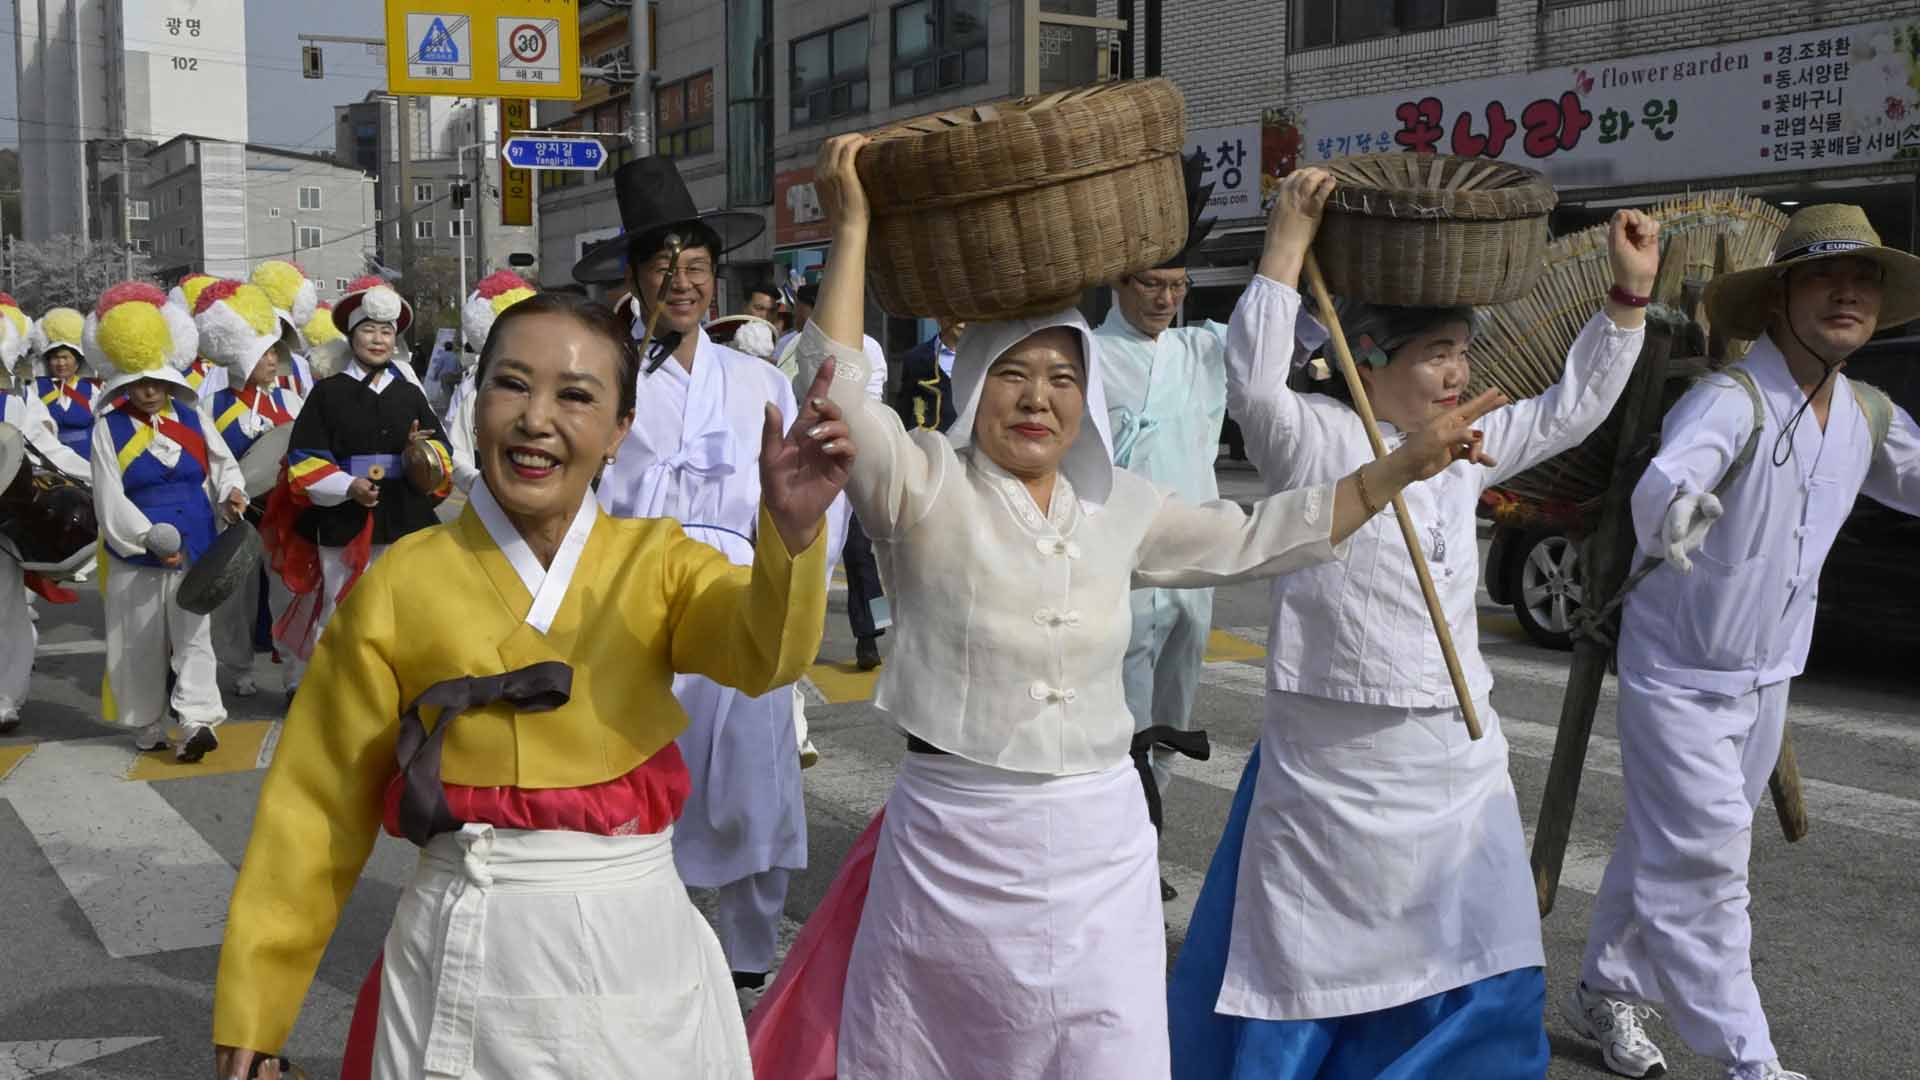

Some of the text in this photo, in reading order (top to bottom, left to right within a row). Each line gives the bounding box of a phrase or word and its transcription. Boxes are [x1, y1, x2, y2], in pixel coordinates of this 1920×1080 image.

[166, 18, 200, 37] 광명
[518, 35, 538, 52] 30
[171, 56, 198, 70] 102
[1602, 53, 1748, 88] flower garden
[1775, 87, 1842, 114] 꽃바구니
[1317, 91, 1678, 159] 향기담은 꽃나라 화원
[1774, 112, 1841, 138] 관엽식물
[1866, 122, 1920, 152] 서비스
[512, 147, 523, 157] 97
[535, 142, 573, 157] 양지길
